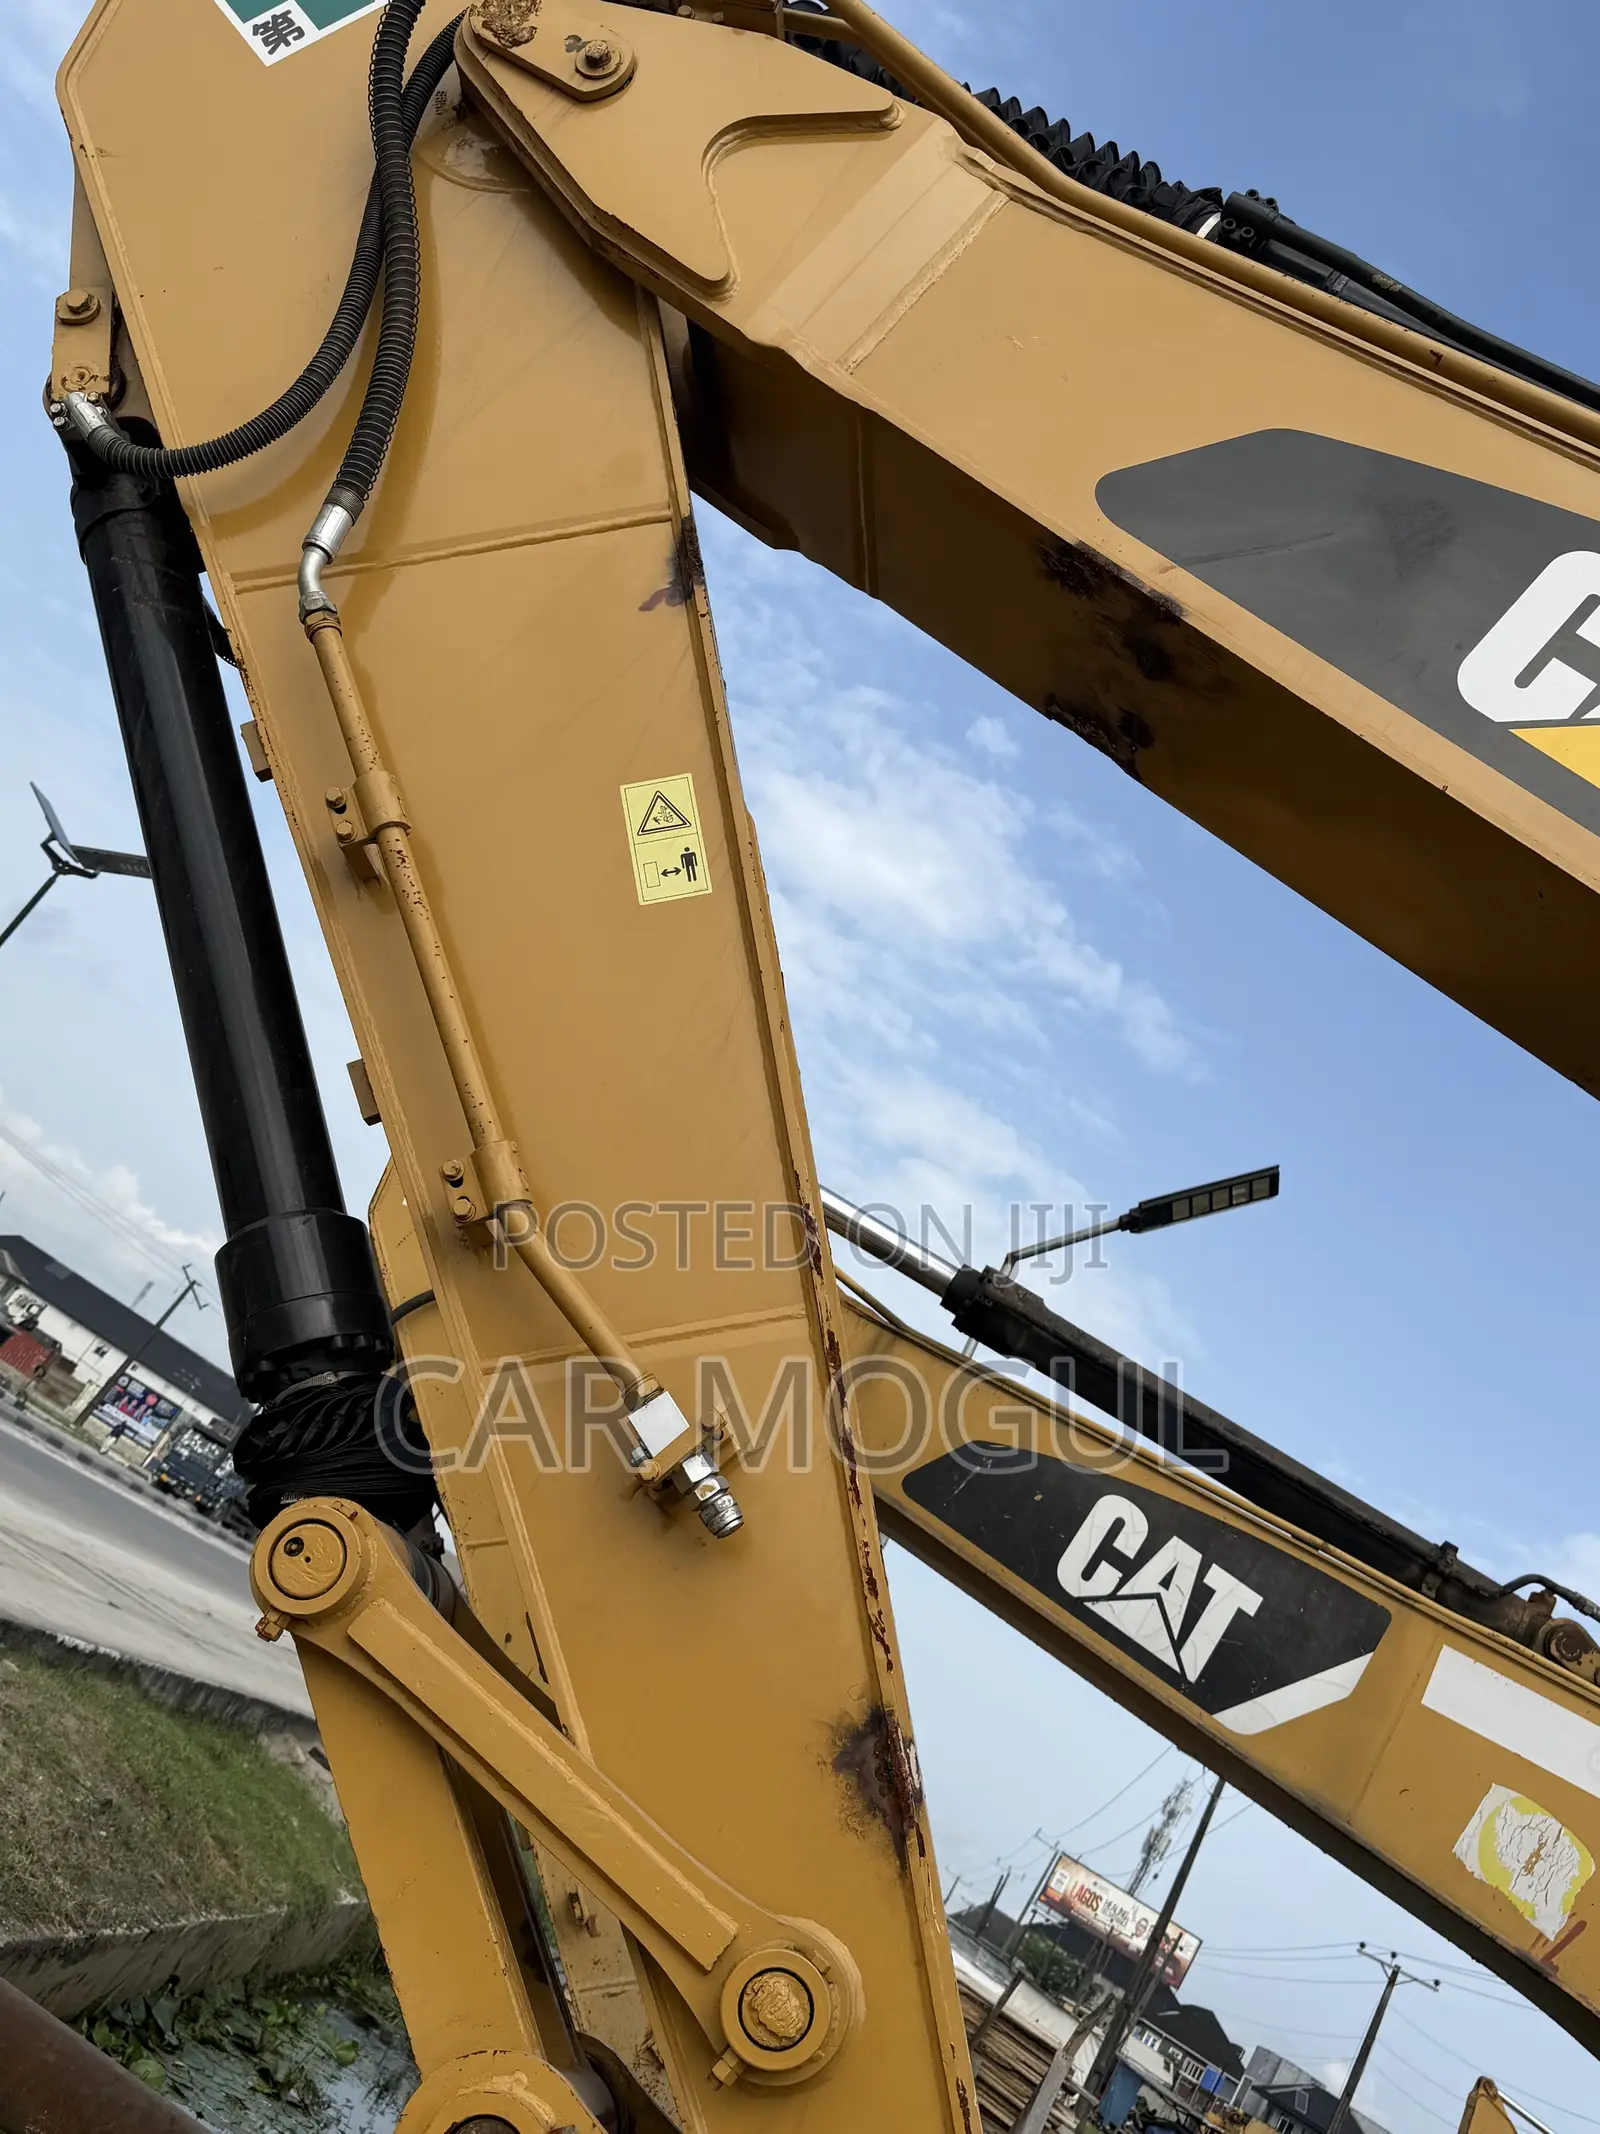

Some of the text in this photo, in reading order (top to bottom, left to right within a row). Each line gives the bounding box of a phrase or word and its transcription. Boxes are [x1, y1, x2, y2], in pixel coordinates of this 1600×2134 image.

[252, 9, 305, 55] 第
[1457, 550, 1600, 722] C
[1056, 1494, 1264, 1684] CAT
[1070, 1880, 1103, 1912] LAGOS
